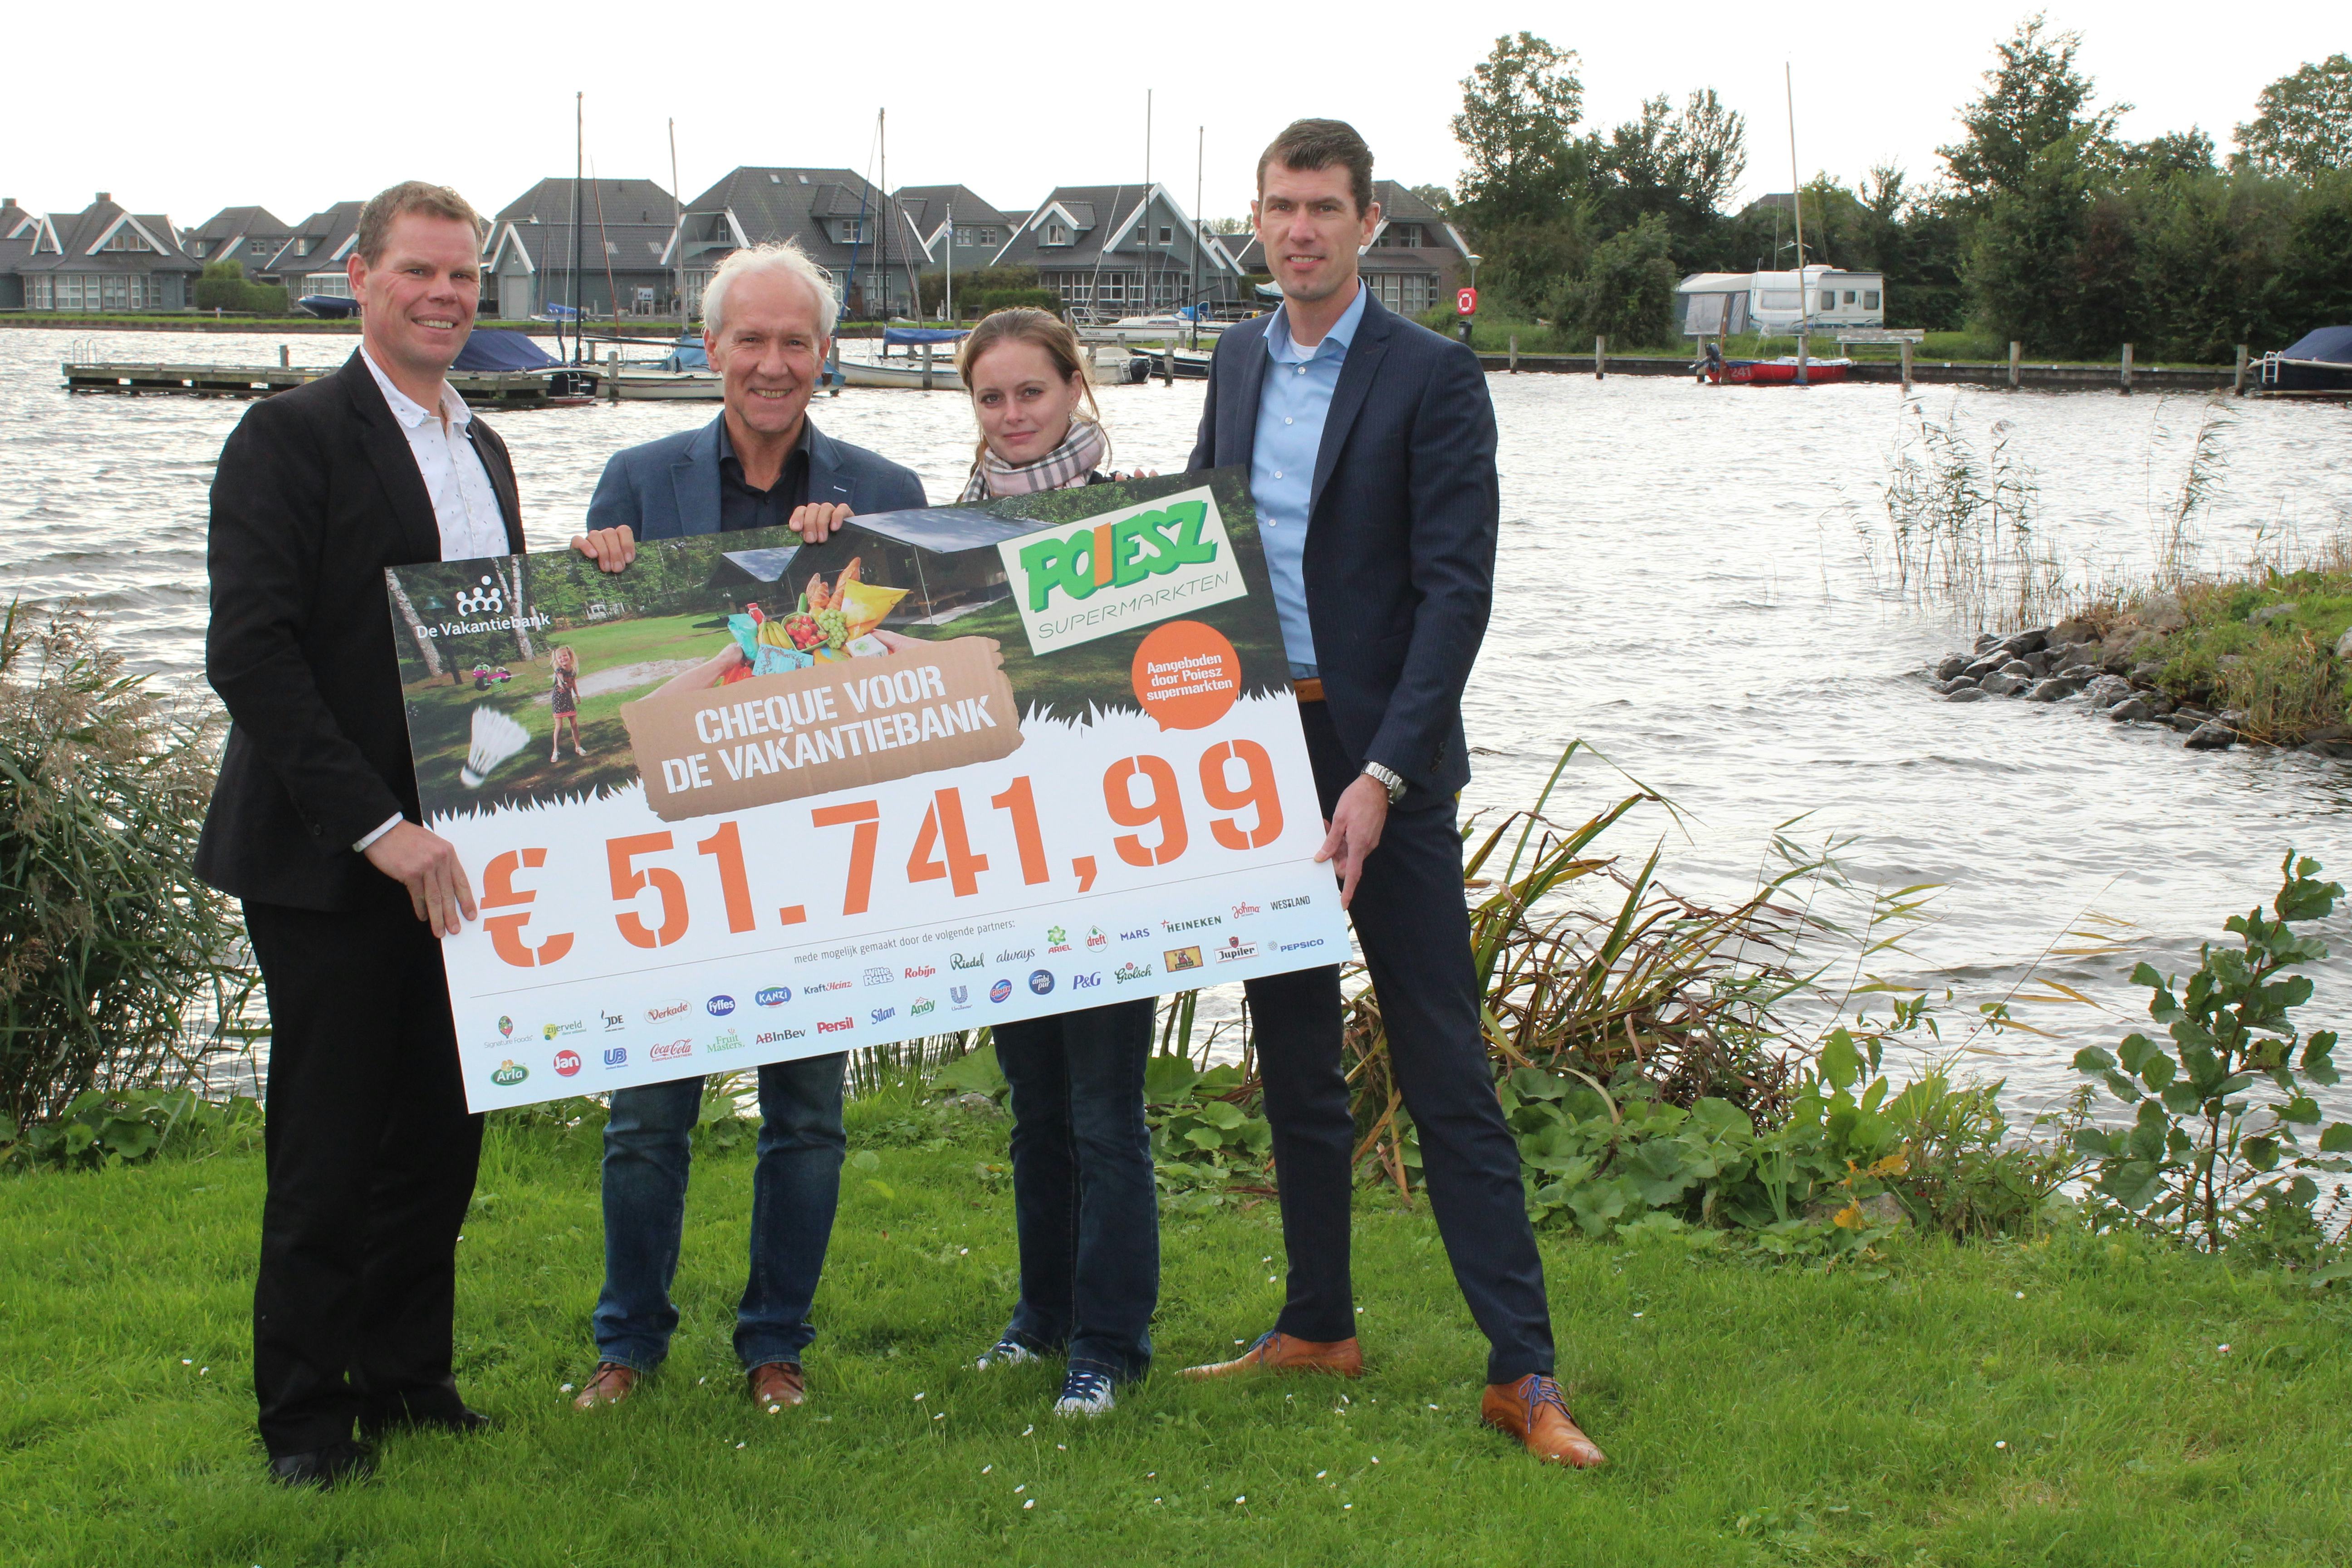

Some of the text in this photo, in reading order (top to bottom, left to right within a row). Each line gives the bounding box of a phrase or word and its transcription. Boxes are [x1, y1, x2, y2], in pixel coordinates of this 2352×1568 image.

[1730, 367, 1751, 377] 241
[1019, 500, 1218, 613] POIESZ
[1038, 571, 1228, 639] SUPERMARKTEN
[416, 613, 551, 639] De Vakantiebank
[1147, 653, 1222, 675] Aangeboden
[1151, 667, 1223, 688] door Poiesz
[1146, 678, 1233, 701] supermarkten
[695, 665, 946, 745] CHEQUE VOOR
[662, 695, 997, 794] DE VAKANTIEBANK
[479, 739, 1284, 968] € 51.741,99
[1232, 902, 1260, 919] Johma
[1270, 896, 1310, 910] WESTLAND
[1167, 916, 1222, 933] HEINEKEN
[794, 920, 1016, 964] mede mogelijk gemaakt door de volgende partners:
[1087, 934, 1106, 946] dreft
[1120, 928, 1150, 941] MARS
[1048, 945, 1072, 954] ARIEL
[1280, 938, 1324, 952] PEPSICO
[996, 947, 1035, 962] always
[1219, 946, 1255, 960] Jupiler
[950, 952, 985, 970] Riedel
[865, 966, 890, 976] Witte
[904, 965, 936, 979] Robijn
[1114, 964, 1152, 984] Grolsch
[863, 972, 894, 986] Reus
[1032, 975, 1049, 985] ambi
[1038, 980, 1050, 990] pur
[1073, 971, 1101, 990] P&G
[990, 985, 1010, 997] Glorix
[648, 1003, 688, 1020] Verkade
[871, 1006, 896, 1025] Silan
[911, 1000, 936, 1017] Andy
[547, 1020, 582, 1034] zijerveld
[604, 1015, 623, 1029] JDE
[817, 1017, 854, 1034] Persil
[484, 1039, 513, 1049] Signature
[715, 1034, 739, 1044] Fruit
[755, 1029, 807, 1044] ABInBev
[554, 1056, 579, 1069] Jan
[604, 1048, 627, 1065] UB
[497, 1068, 523, 1082] Arla
